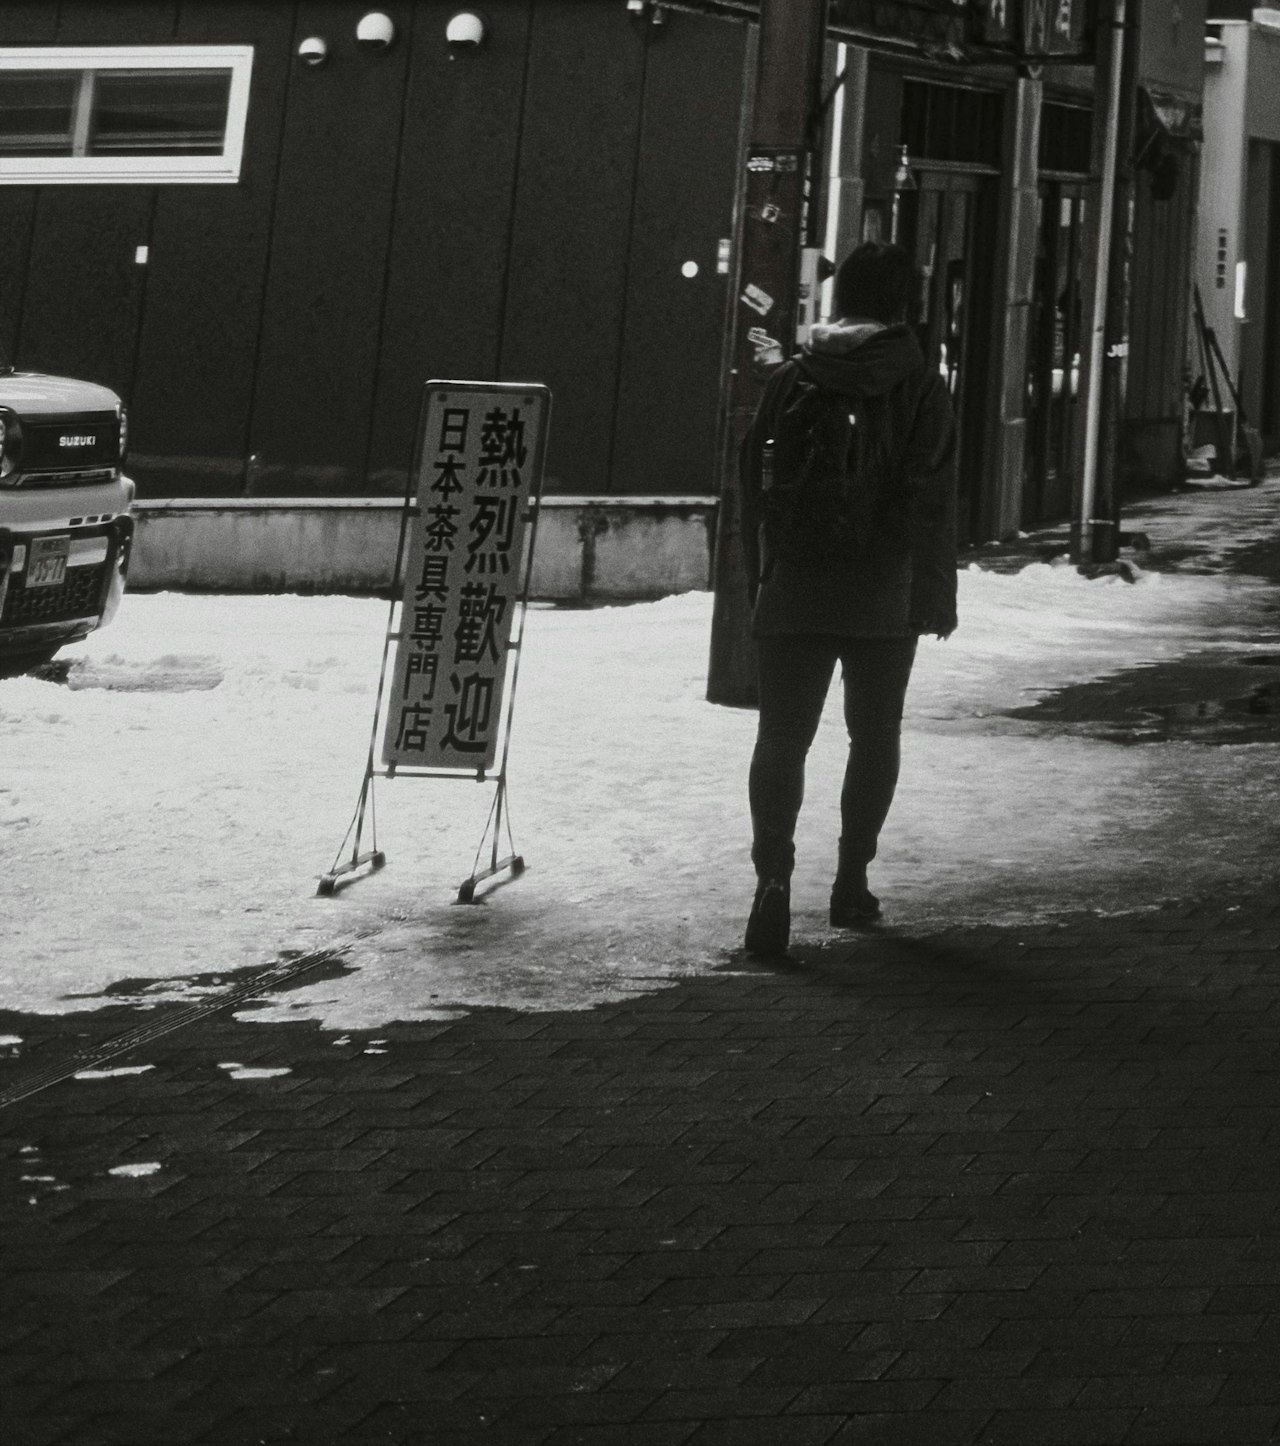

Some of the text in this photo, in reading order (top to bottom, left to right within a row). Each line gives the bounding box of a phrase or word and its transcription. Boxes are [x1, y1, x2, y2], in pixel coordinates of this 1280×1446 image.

[59, 435, 96, 447] SUZUKI
[395, 408, 470, 752] 日本茶具専門店
